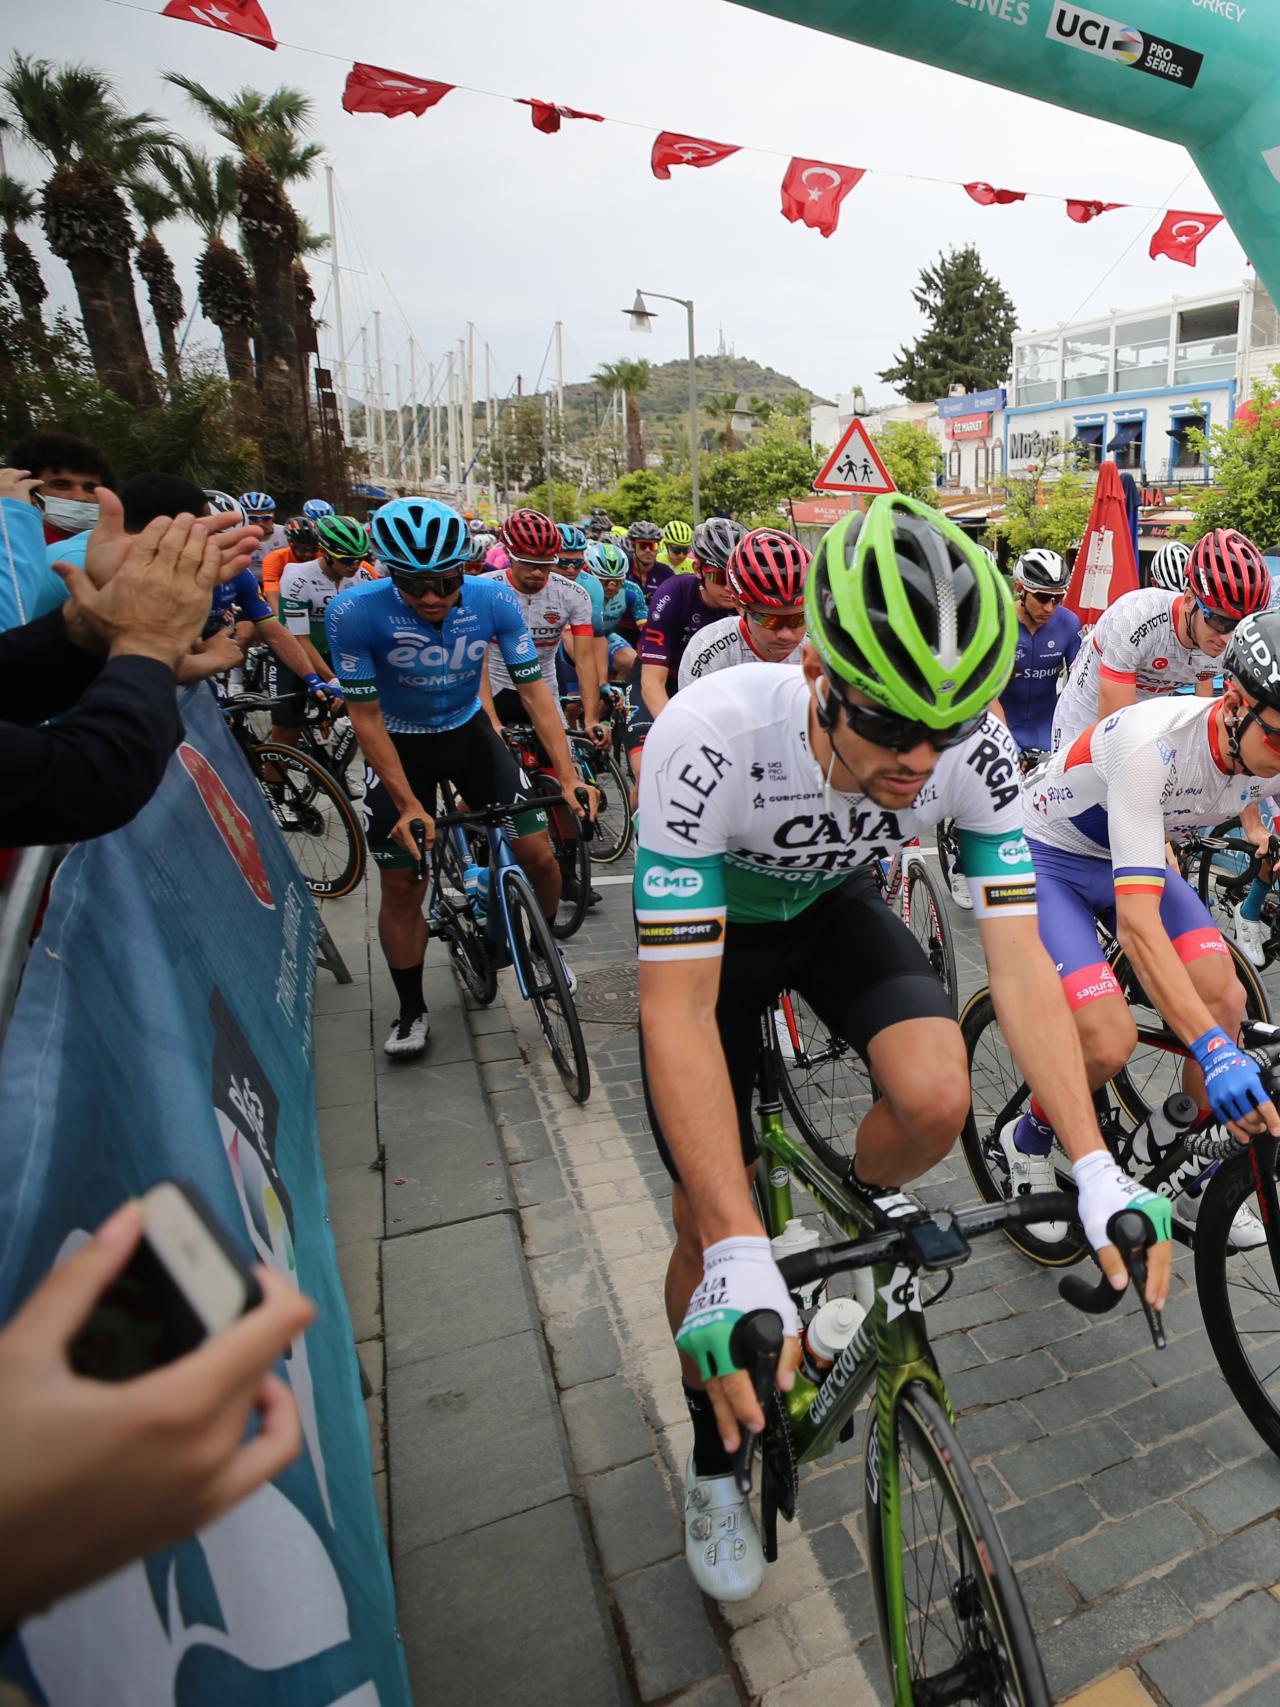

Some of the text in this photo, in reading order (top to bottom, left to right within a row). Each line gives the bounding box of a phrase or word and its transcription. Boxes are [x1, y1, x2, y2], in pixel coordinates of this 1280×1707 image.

[957, 0, 1030, 26] INES
[1056, 9, 1110, 50] UCI
[1149, 42, 1173, 61] PRO
[1144, 56, 1184, 78] SERIES
[962, 420, 982, 432] MARKET
[289, 577, 308, 600] ALEA
[552, 575, 589, 601] SPORTOTO
[657, 595, 671, 612] aldro
[1130, 612, 1168, 647] SPORTOTO
[387, 635, 488, 670] eolo
[691, 632, 738, 678] SPORTOTO
[399, 669, 476, 686] KOMETA
[967, 738, 1019, 812] RGA
[666, 745, 732, 844] ALEA
[773, 811, 905, 849] CAJA
[647, 875, 698, 888] KMC
[1076, 980, 1114, 1000] sapura
